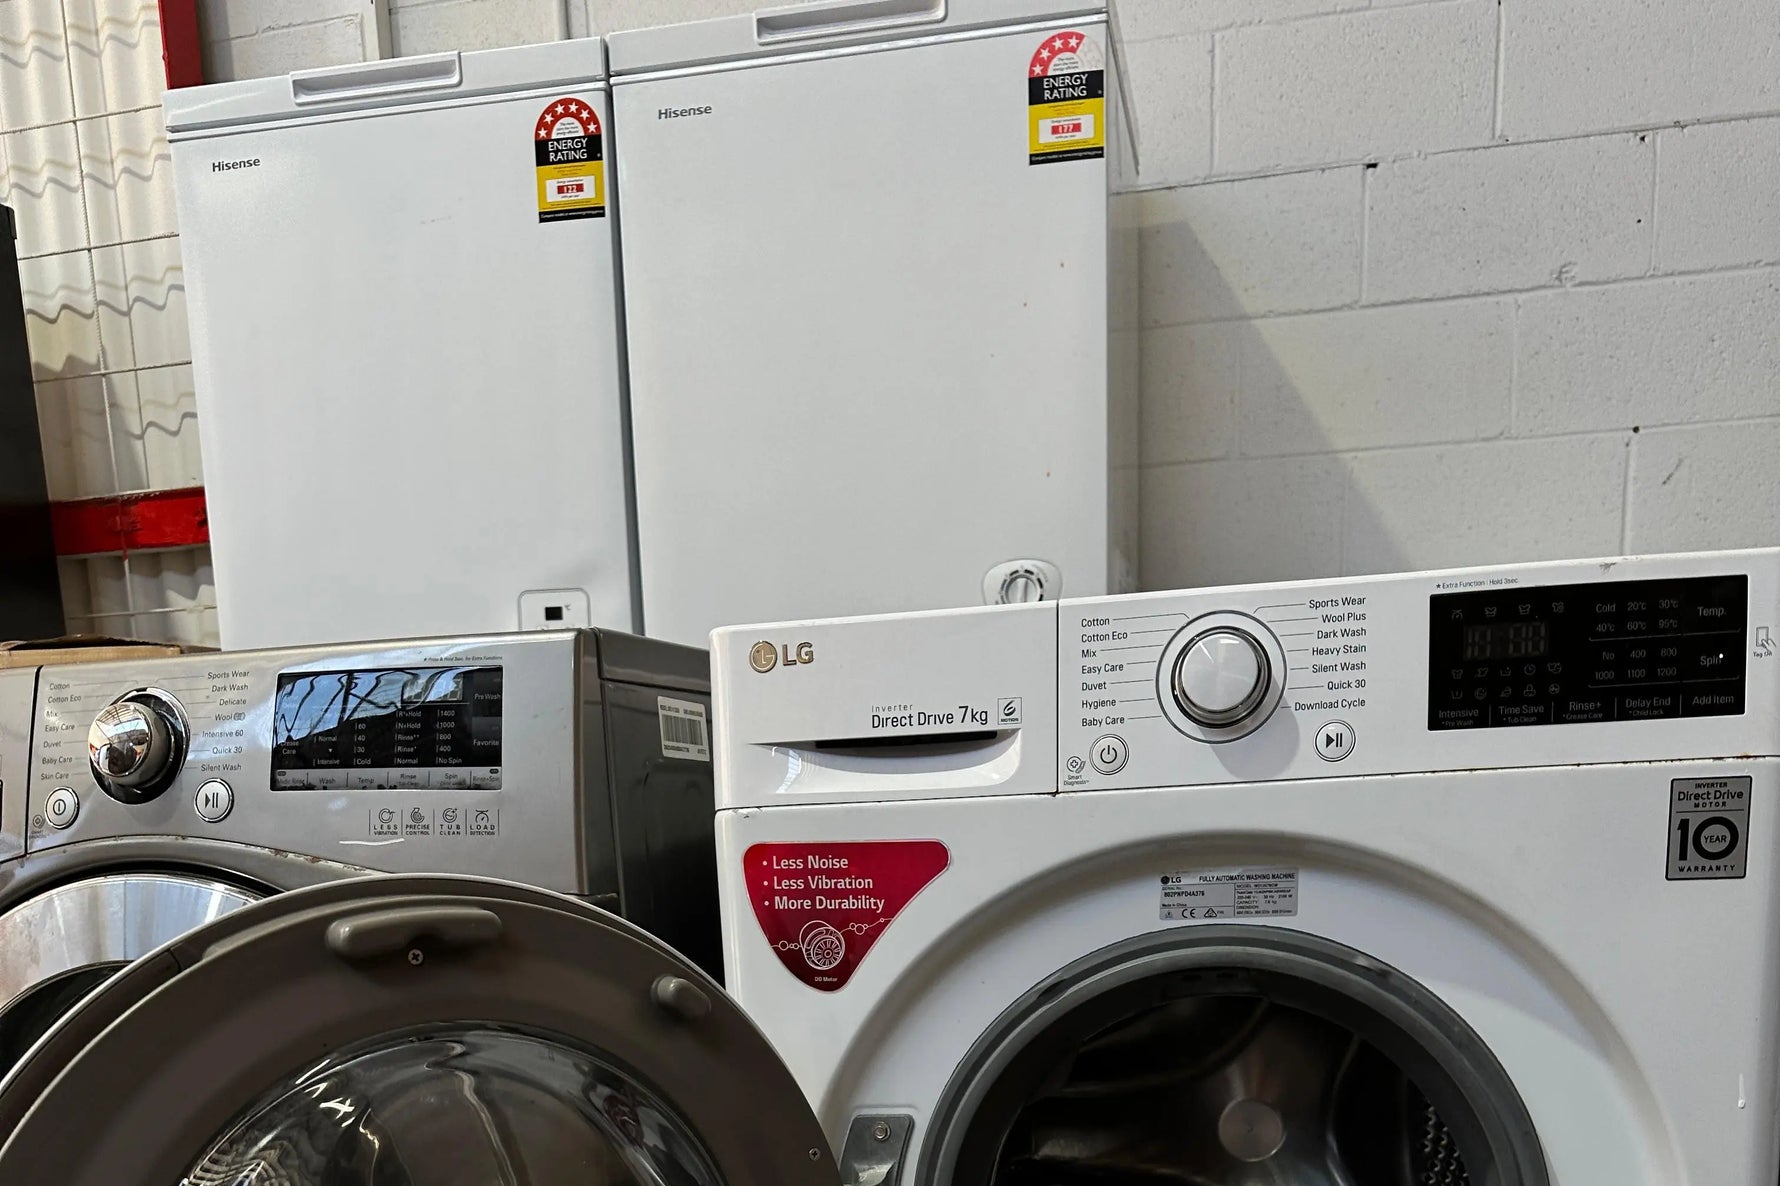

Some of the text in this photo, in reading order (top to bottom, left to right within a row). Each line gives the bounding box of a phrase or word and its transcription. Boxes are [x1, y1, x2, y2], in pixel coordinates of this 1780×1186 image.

[1043, 74, 1088, 89] ENERGY
[1044, 86, 1087, 100] RATING
[658, 105, 712, 120] Hisense
[548, 138, 588, 151] ENERGY
[549, 149, 587, 162] RATING
[212, 158, 261, 172] Hisense
[563, 185, 577, 193] 122
[1309, 597, 1366, 610] Sports Wear
[1596, 603, 1616, 613] Cold
[1081, 618, 1110, 627] Cotton
[1322, 612, 1367, 623] Wool Plus
[1081, 631, 1128, 642] Cotton Eco
[1317, 627, 1367, 639] Dark Wash
[781, 641, 815, 666] LG
[1081, 649, 1097, 658] Mix
[1312, 643, 1367, 656] Heavy Stain
[1602, 648, 1722, 667] No 400 800 Spin
[1081, 663, 1124, 674] Easy Care
[1312, 661, 1367, 673] Silent Wash
[207, 670, 250, 680] Sports Wear
[1595, 667, 1677, 680] 1000 1100 1200
[49, 682, 71, 690] Cotton
[211, 683, 249, 693] Dark Wash
[1081, 681, 1107, 691] Duvet
[1327, 679, 1366, 690] Quick 30
[47, 694, 82, 704] Cotton Eco
[219, 698, 247, 706] Delicate
[1081, 699, 1116, 709] Hygiene
[1294, 698, 1366, 711] Download Cycle
[1625, 697, 1671, 709] Delay End
[1692, 694, 1735, 705] Add Item
[871, 704, 913, 712] Inverter
[1499, 704, 1544, 714] Time Save
[1569, 700, 1602, 711] Rinse+
[45, 710, 58, 718] Mix
[214, 713, 233, 721] Wool
[872, 705, 988, 729] Direct Drive 7kg
[1439, 708, 1479, 718] Intensive
[1081, 716, 1125, 727] Baby Care
[45, 723, 76, 733] Easy Care
[234, 729, 244, 737] 60
[43, 740, 62, 748] Duvet
[212, 746, 243, 755] Quick 30
[41, 755, 73, 766] Baby Care
[200, 764, 221, 772] Silent
[40, 771, 69, 780] Skin Care
[1694, 781, 1728, 789] INVERTER
[1677, 789, 1744, 801] Direct Drive
[1676, 816, 1739, 861] 10
[1703, 835, 1727, 843] YEAR
[772, 855, 849, 869] Less Noise
[1678, 864, 1736, 873] WARRANTY
[773, 875, 873, 890] Less Vibration
[1170, 876, 1182, 884] LG
[1216, 874, 1246, 882] AUTOMATIC
[1246, 873, 1271, 881] WASHING
[1271, 872, 1296, 880] MACHINE
[774, 894, 885, 913] More Durability
